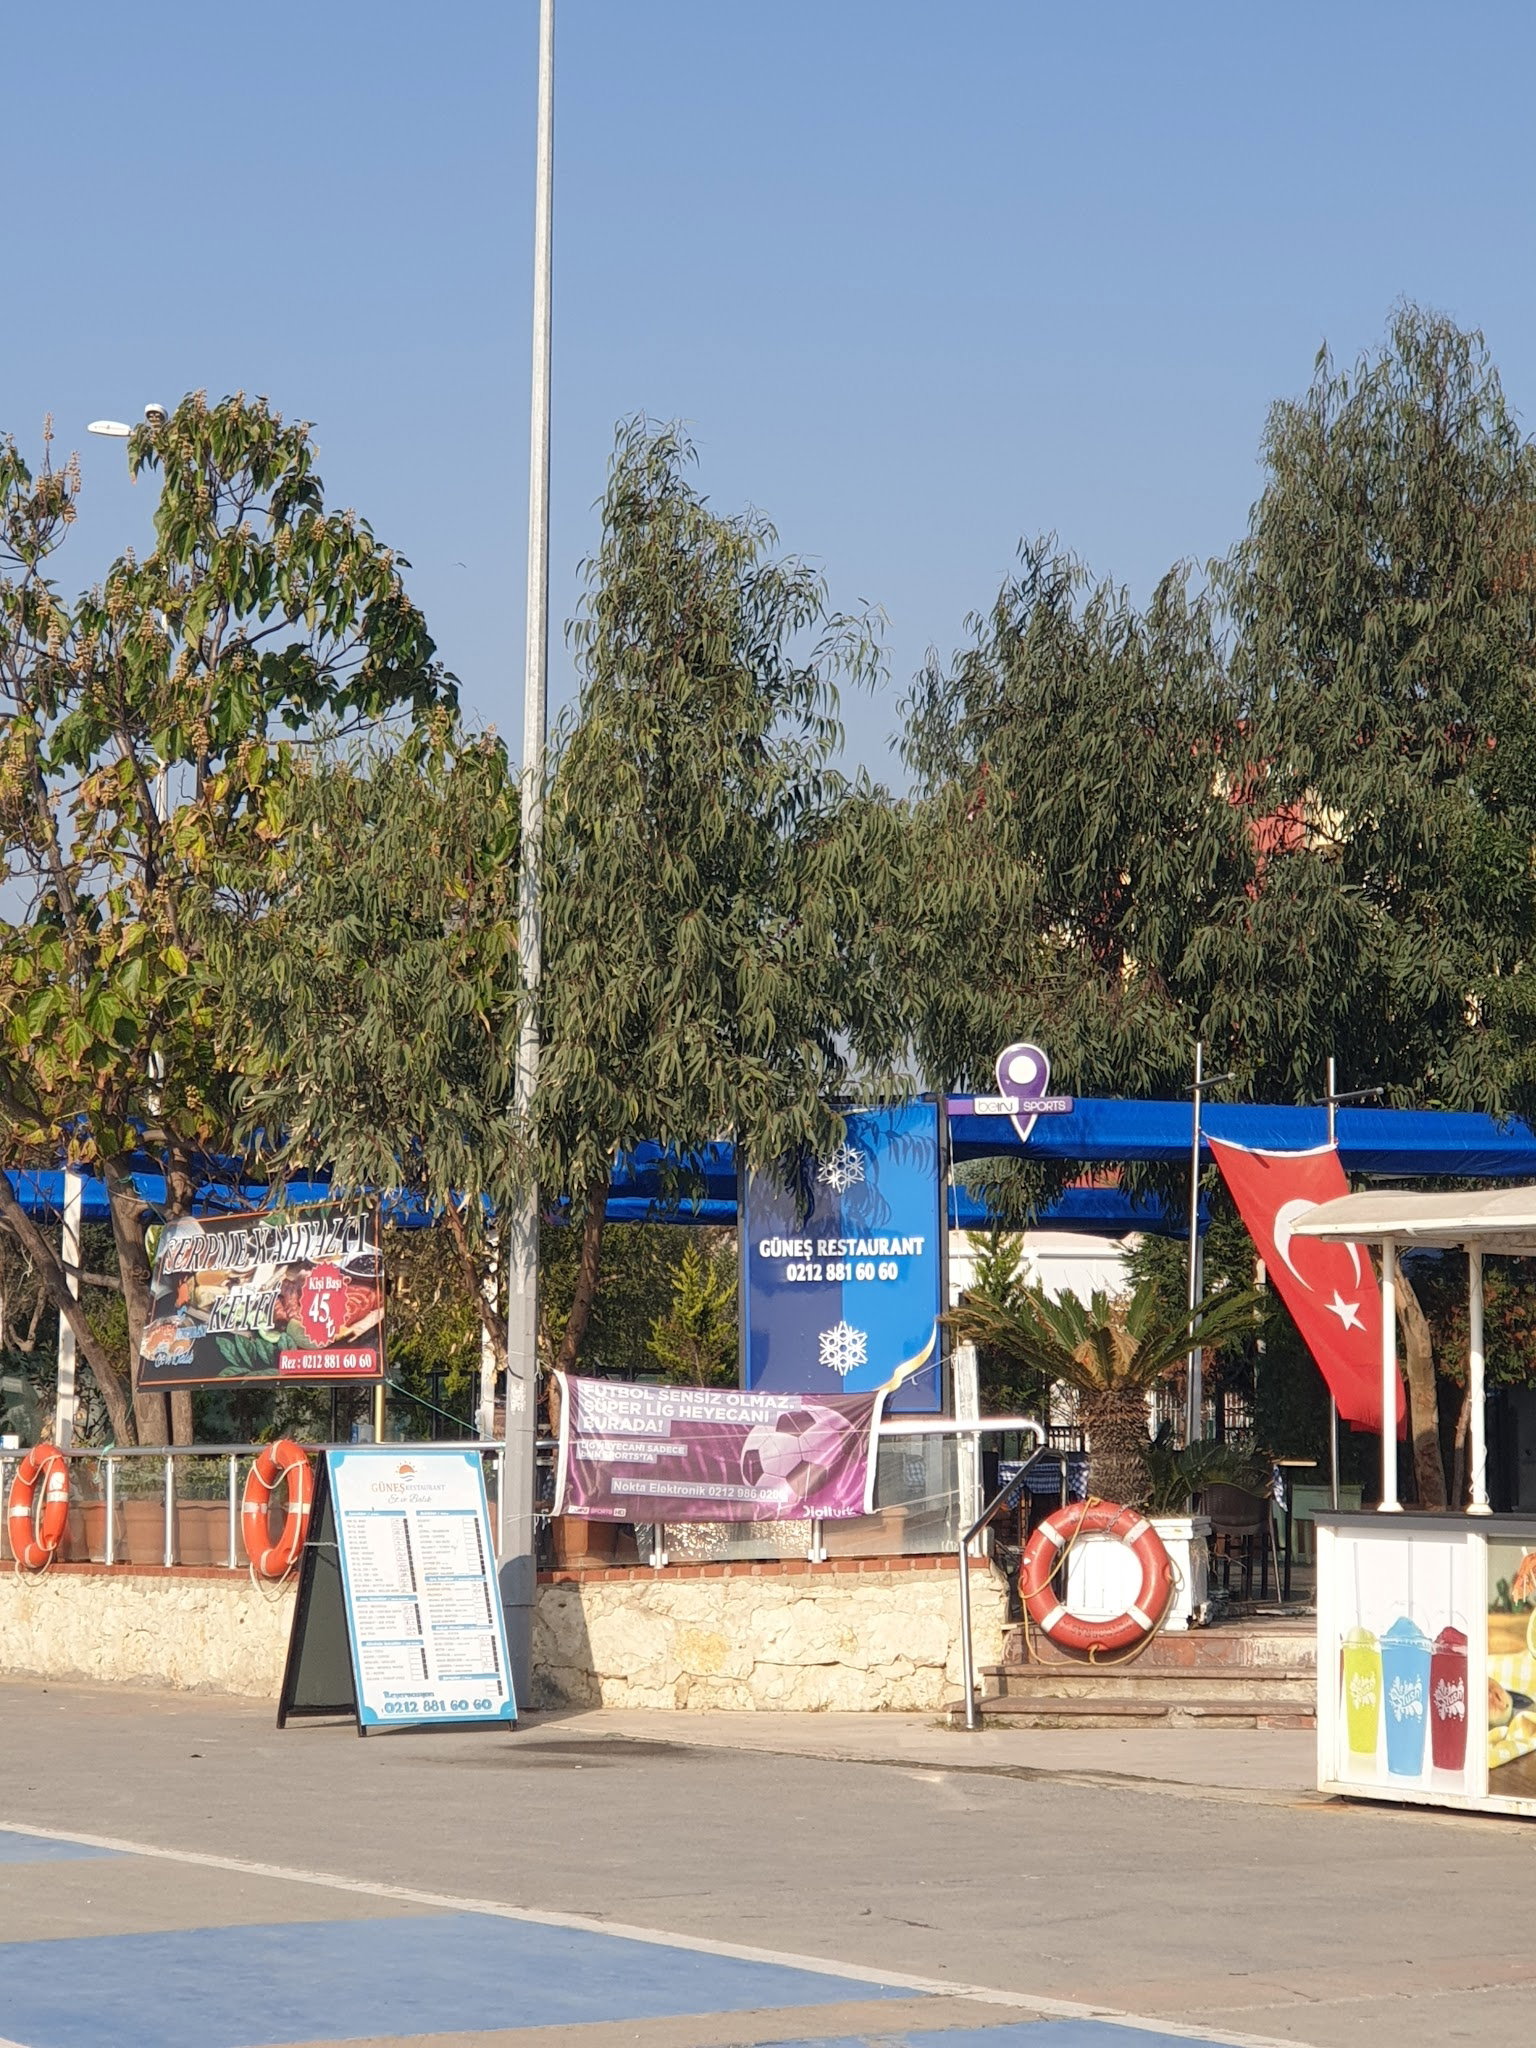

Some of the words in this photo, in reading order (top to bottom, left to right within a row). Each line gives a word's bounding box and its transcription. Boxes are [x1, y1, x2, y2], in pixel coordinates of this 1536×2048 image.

[1023, 1100, 1066, 1112] SPORTS
[163, 1229, 250, 1274] SERPME
[759, 1237, 813, 1261] GÜNEŞ
[817, 1237, 925, 1257] RESTAURANT
[786, 1263, 823, 1282] 0212
[826, 1263, 852, 1281] 881
[856, 1262, 875, 1281] 60
[878, 1262, 898, 1280] 60
[308, 1276, 325, 1292] Kişi
[308, 1293, 331, 1323] 45
[302, 1354, 322, 1369] 0212
[324, 1354, 340, 1368] 881
[343, 1354, 356, 1368] 60
[359, 1353, 372, 1368] 60
[583, 1384, 654, 1400] FUTBOL
[658, 1389, 721, 1405] SENSİZ
[726, 1395, 795, 1409] OLMAZ.
[584, 1397, 642, 1415] SÜPER
[646, 1401, 674, 1417] LİG
[679, 1405, 769, 1422] HEYECANI
[583, 1416, 664, 1432] BURADA!
[647, 1445, 685, 1455] SADECE
[371, 1481, 405, 1494] GÜNEŞ
[613, 1481, 646, 1492] Nokta
[649, 1483, 705, 1496] Elektronik
[708, 1487, 735, 1498] 0212
[385, 1702, 419, 1714] 0212
[423, 1700, 446, 1712] 881
[450, 1699, 469, 1711] 60
[473, 1698, 493, 1710] 60
